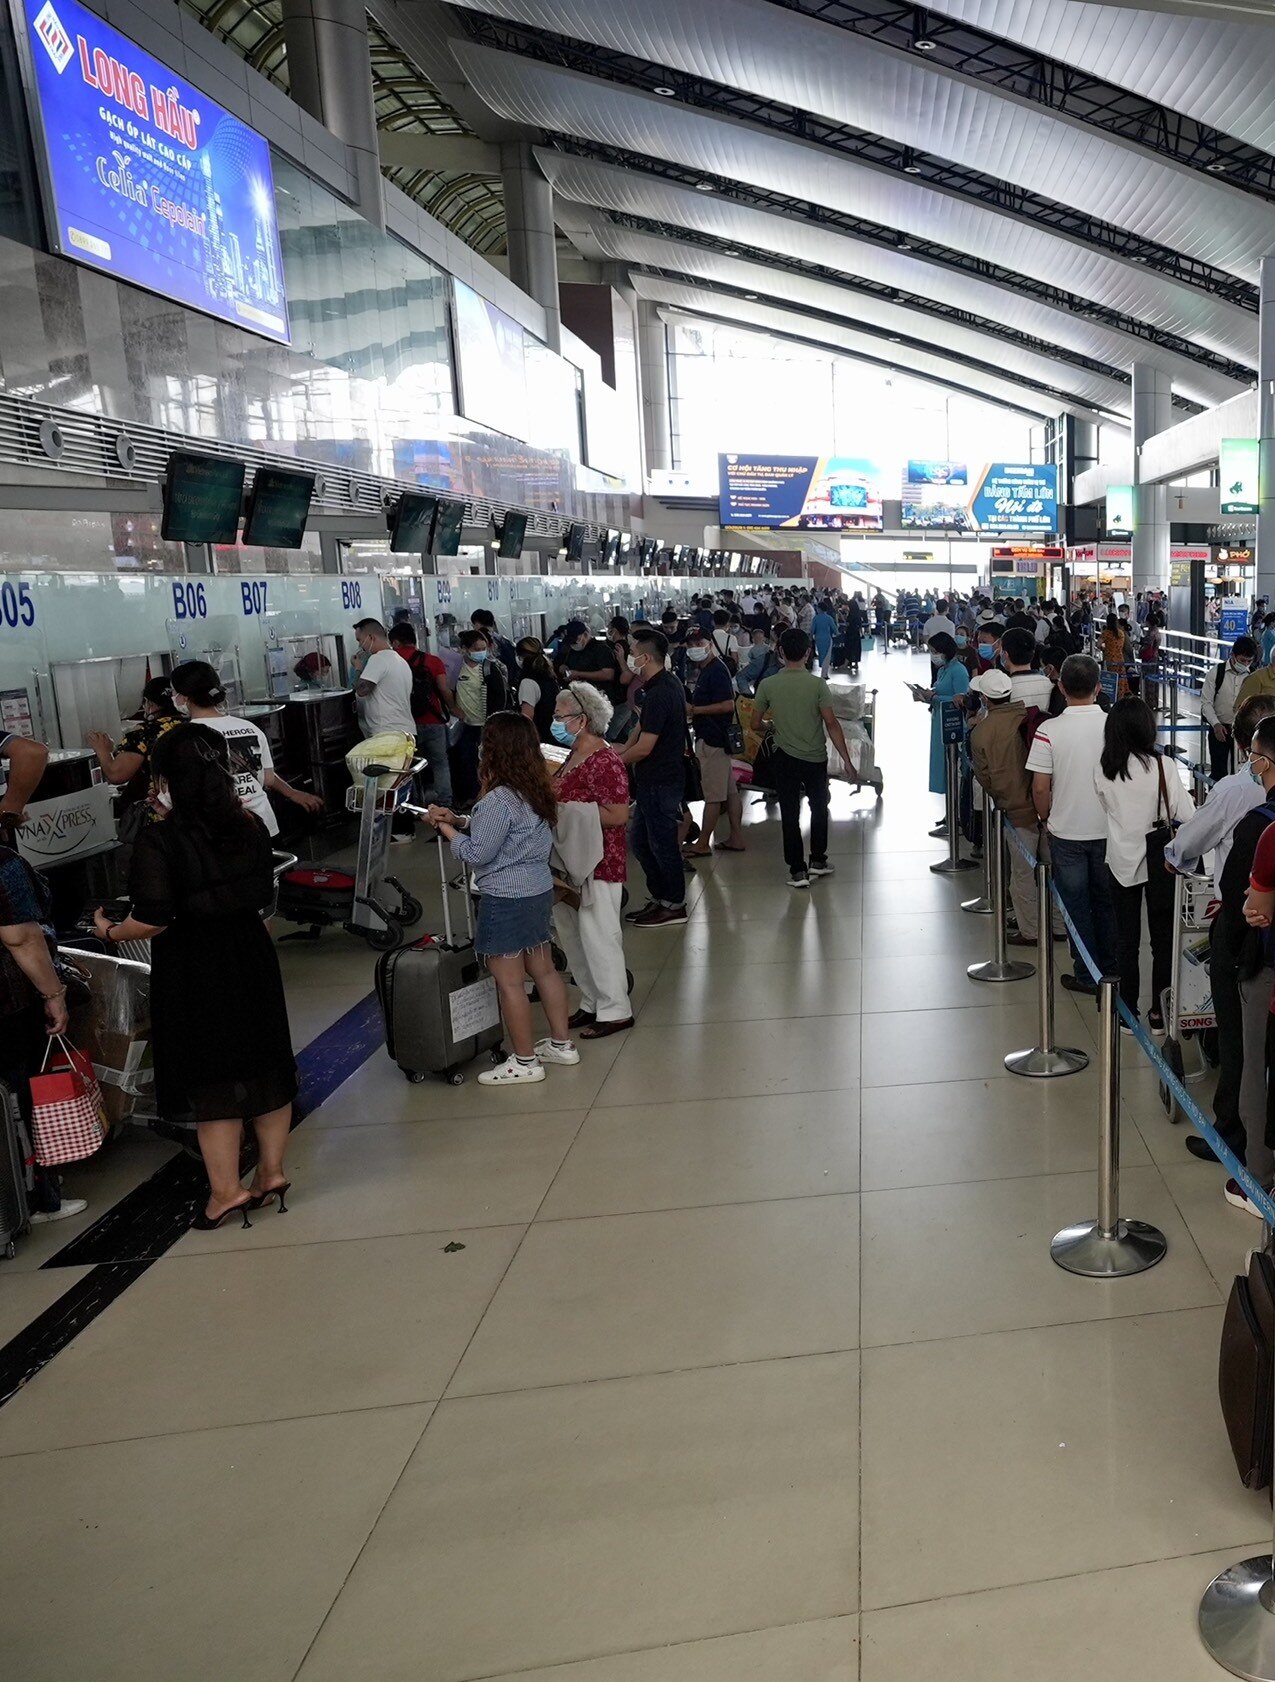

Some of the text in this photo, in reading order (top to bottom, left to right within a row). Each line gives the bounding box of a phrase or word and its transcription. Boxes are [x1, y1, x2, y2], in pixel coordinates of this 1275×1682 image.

[76, 34, 148, 121] LONG
[150, 86, 198, 151] HẦU
[98, 106, 125, 131] GẠCH
[141, 131, 156, 150] LÁT
[158, 143, 175, 161] CAO
[96, 155, 148, 208] Celia
[172, 582, 207, 619] B06
[241, 581, 267, 615] B07
[341, 581, 362, 609] B08
[237, 784, 256, 796] EAL
[1180, 1018, 1213, 1028] SONG
